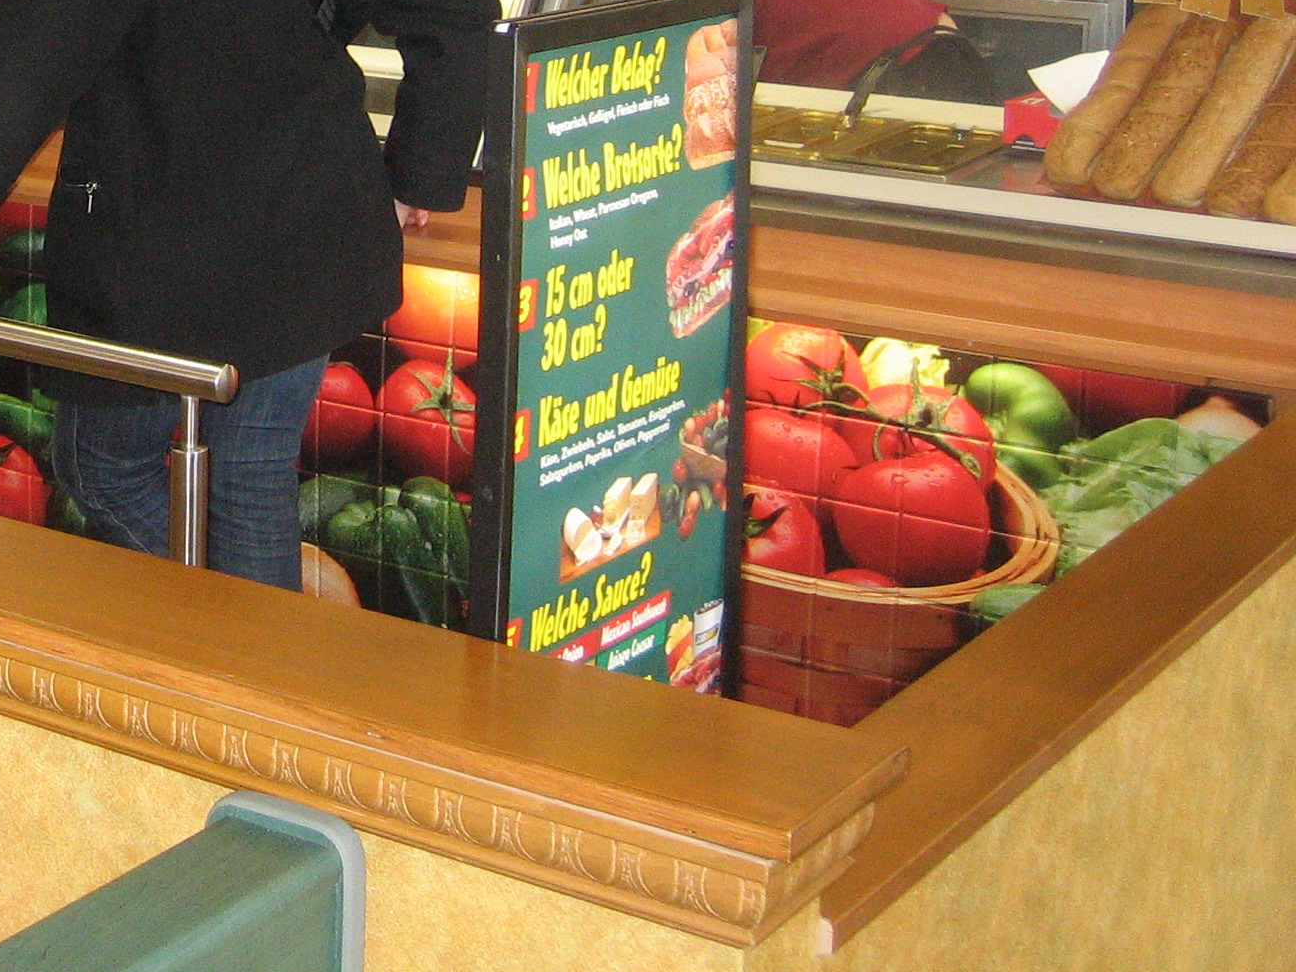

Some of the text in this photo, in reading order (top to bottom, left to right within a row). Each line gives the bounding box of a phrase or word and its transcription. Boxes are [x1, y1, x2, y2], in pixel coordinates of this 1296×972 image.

[545, 36, 667, 109] Welcher Belag?
[547, 114, 588, 137] Vegetarisch,
[616, 101, 638, 117] Fleisch
[638, 98, 653, 112] oder
[653, 93, 670, 108] Fisch
[542, 123, 683, 210] Welche Brotsorte?
[550, 228, 589, 249] Honey Oat
[598, 197, 630, 215] Parmesan
[518, 285, 533, 324] 3
[545, 248, 635, 318] 15 cm oder
[540, 303, 607, 371] 30 cm?
[538, 355, 682, 448] Käse und Gemüse
[530, 551, 653, 653] Welche Sauce?
[600, 620, 632, 647] Mexican
